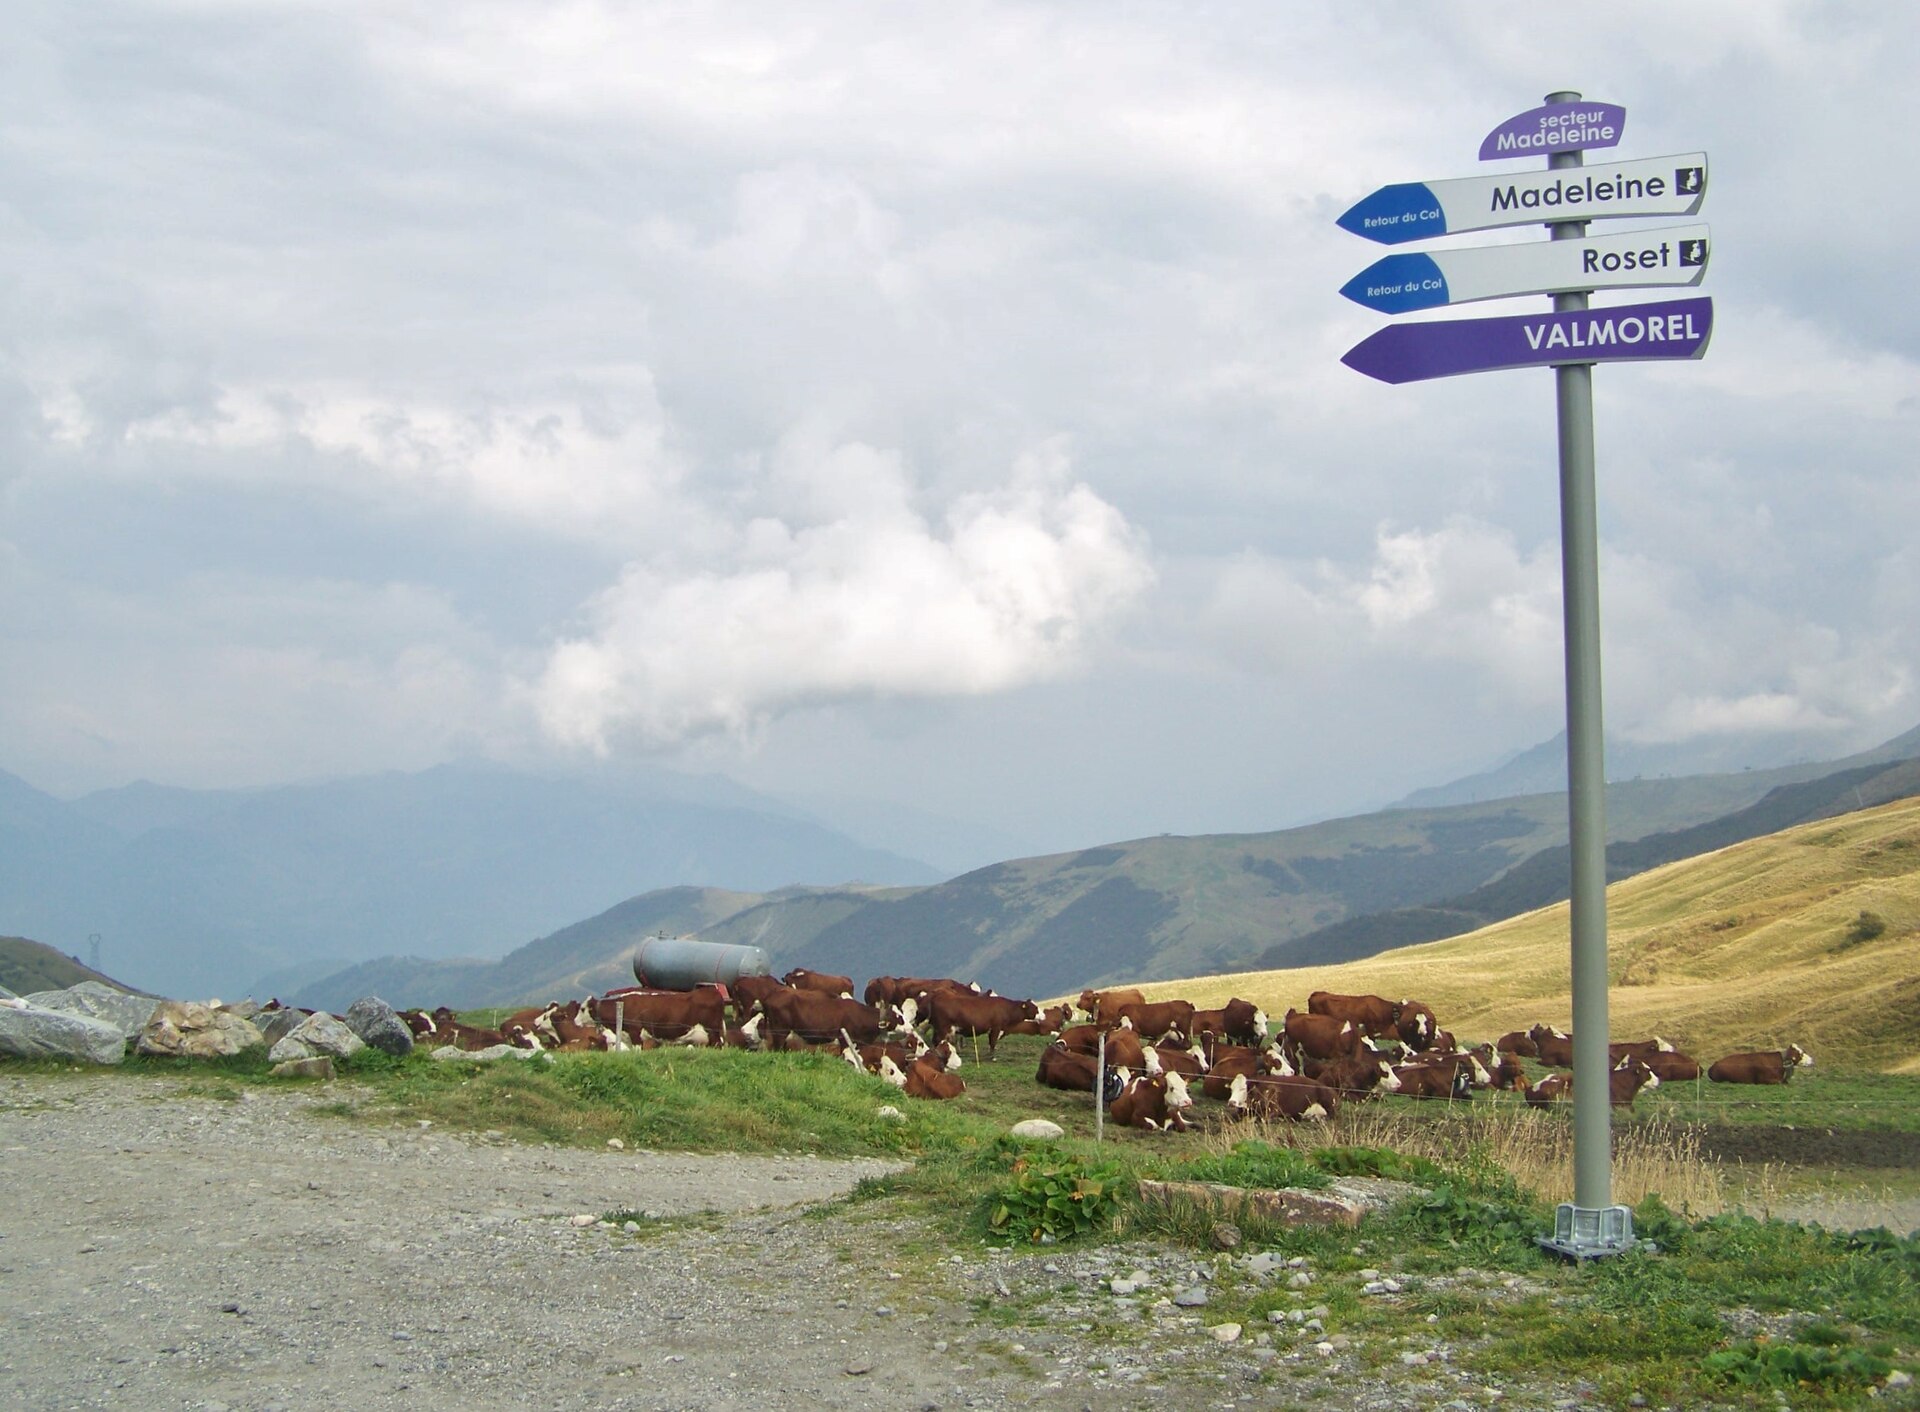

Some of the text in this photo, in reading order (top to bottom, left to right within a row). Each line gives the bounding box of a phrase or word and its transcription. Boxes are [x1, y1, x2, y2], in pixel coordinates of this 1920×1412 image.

[1539, 109, 1605, 128] secteur
[1496, 124, 1615, 151] Madeleine
[1490, 173, 1666, 212] Madeleine
[1363, 208, 1440, 229] Retour du Col
[1582, 241, 1670, 273] Roset
[1366, 278, 1442, 298] Retour du Col
[1523, 313, 1700, 350] VALMOREL
